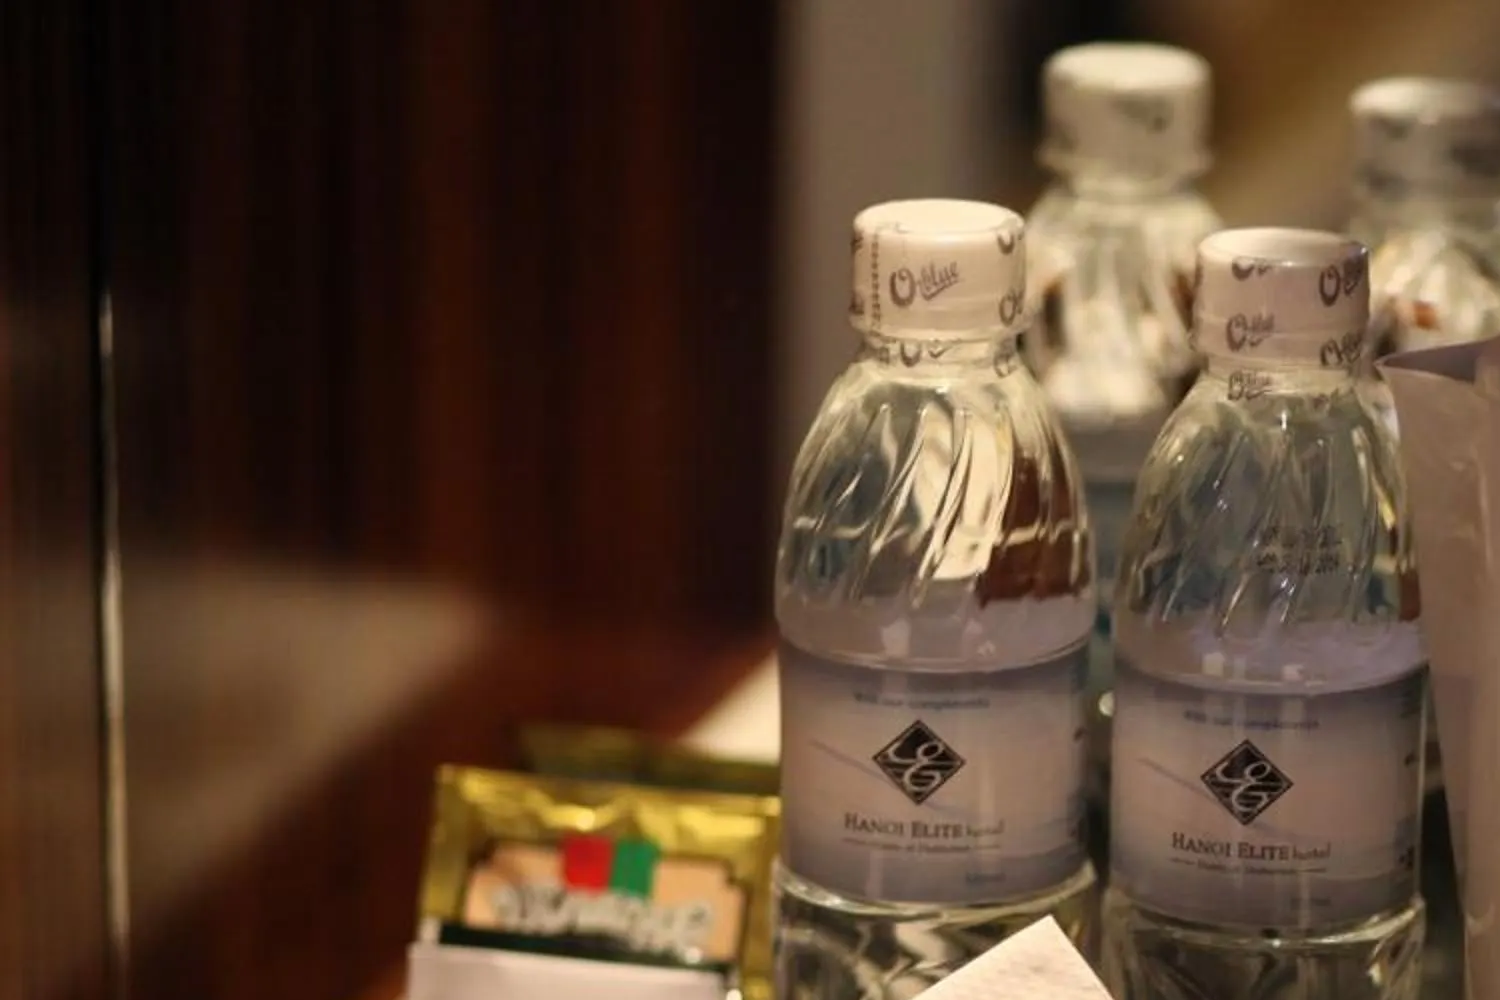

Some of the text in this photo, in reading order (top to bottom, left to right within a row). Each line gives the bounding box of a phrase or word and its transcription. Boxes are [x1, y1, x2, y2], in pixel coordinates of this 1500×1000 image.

[844, 811, 904, 836] HANOI
[911, 820, 964, 839] ELITE
[1172, 831, 1232, 858] HANOI
[1237, 841, 1290, 861] ELITE
